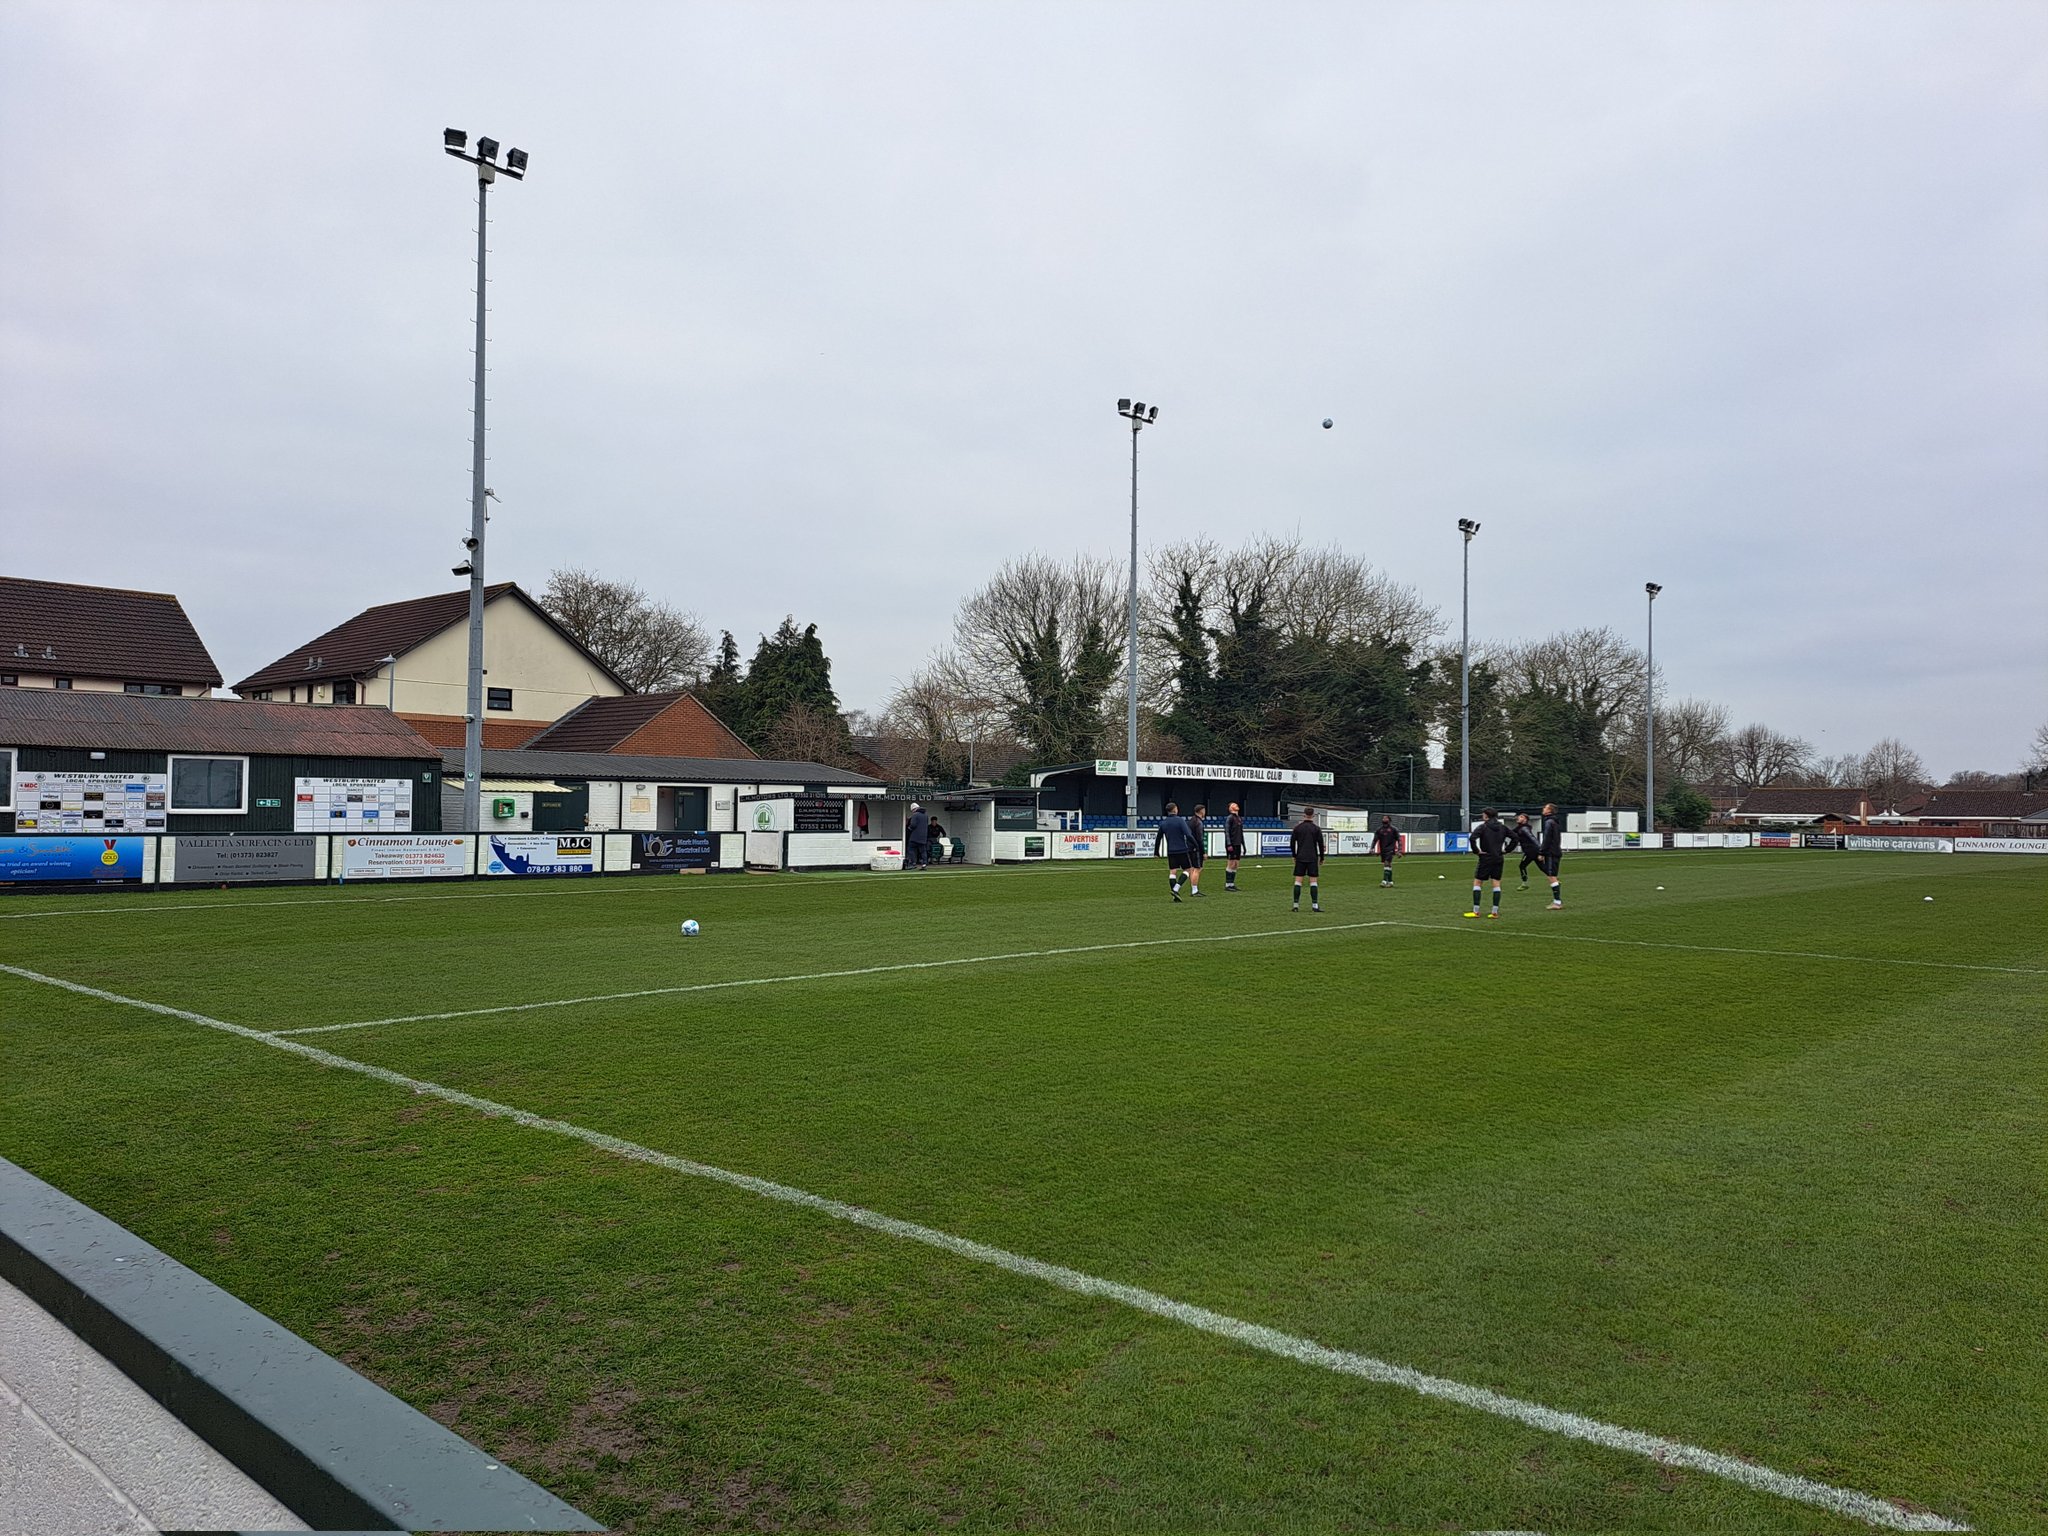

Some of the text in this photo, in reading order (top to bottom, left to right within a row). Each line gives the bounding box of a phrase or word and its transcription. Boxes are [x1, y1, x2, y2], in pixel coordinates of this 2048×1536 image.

[1166, 765, 1282, 780] WESTBURY UNITED FOOTBALL CLUB
[179, 840, 234, 848] VALLETTA
[358, 837, 453, 847] Cinnamon Lounge
[559, 838, 590, 848] MJC
[1851, 838, 1890, 848] wiltshire
[1892, 839, 1935, 849] caravans
